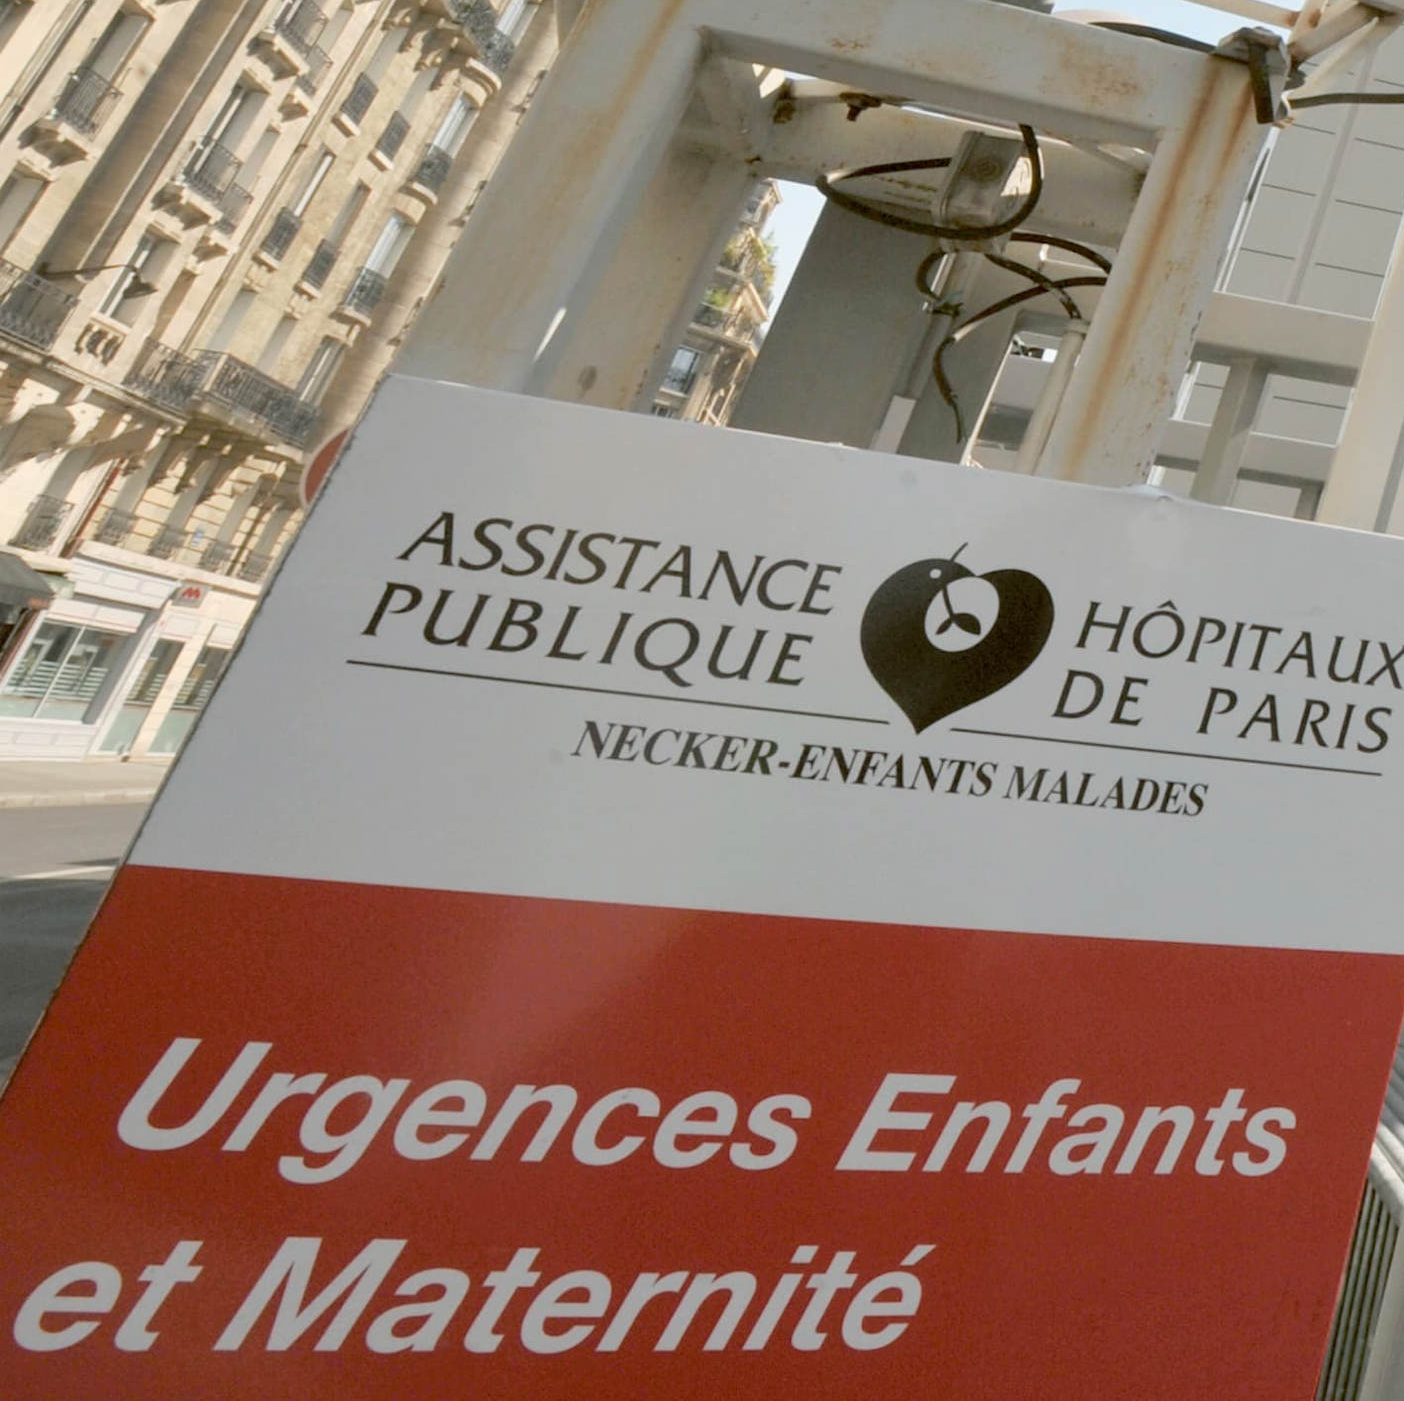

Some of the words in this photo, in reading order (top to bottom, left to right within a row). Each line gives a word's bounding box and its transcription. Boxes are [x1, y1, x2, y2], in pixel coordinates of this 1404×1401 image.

[398, 511, 843, 616] ASSISTANCE
[361, 582, 815, 686] PUBLIQUE
[1051, 668, 1148, 726] DE
[1197, 686, 1392, 755] PARIS
[570, 719, 1000, 800] NECKER-ENFANTS
[1002, 765, 1209, 818] MALADES
[116, 1037, 812, 1185] Urgences
[835, 1072, 1297, 1177] Enfants
[12, 1240, 205, 1352] et
[213, 1235, 937, 1354] Maternité
